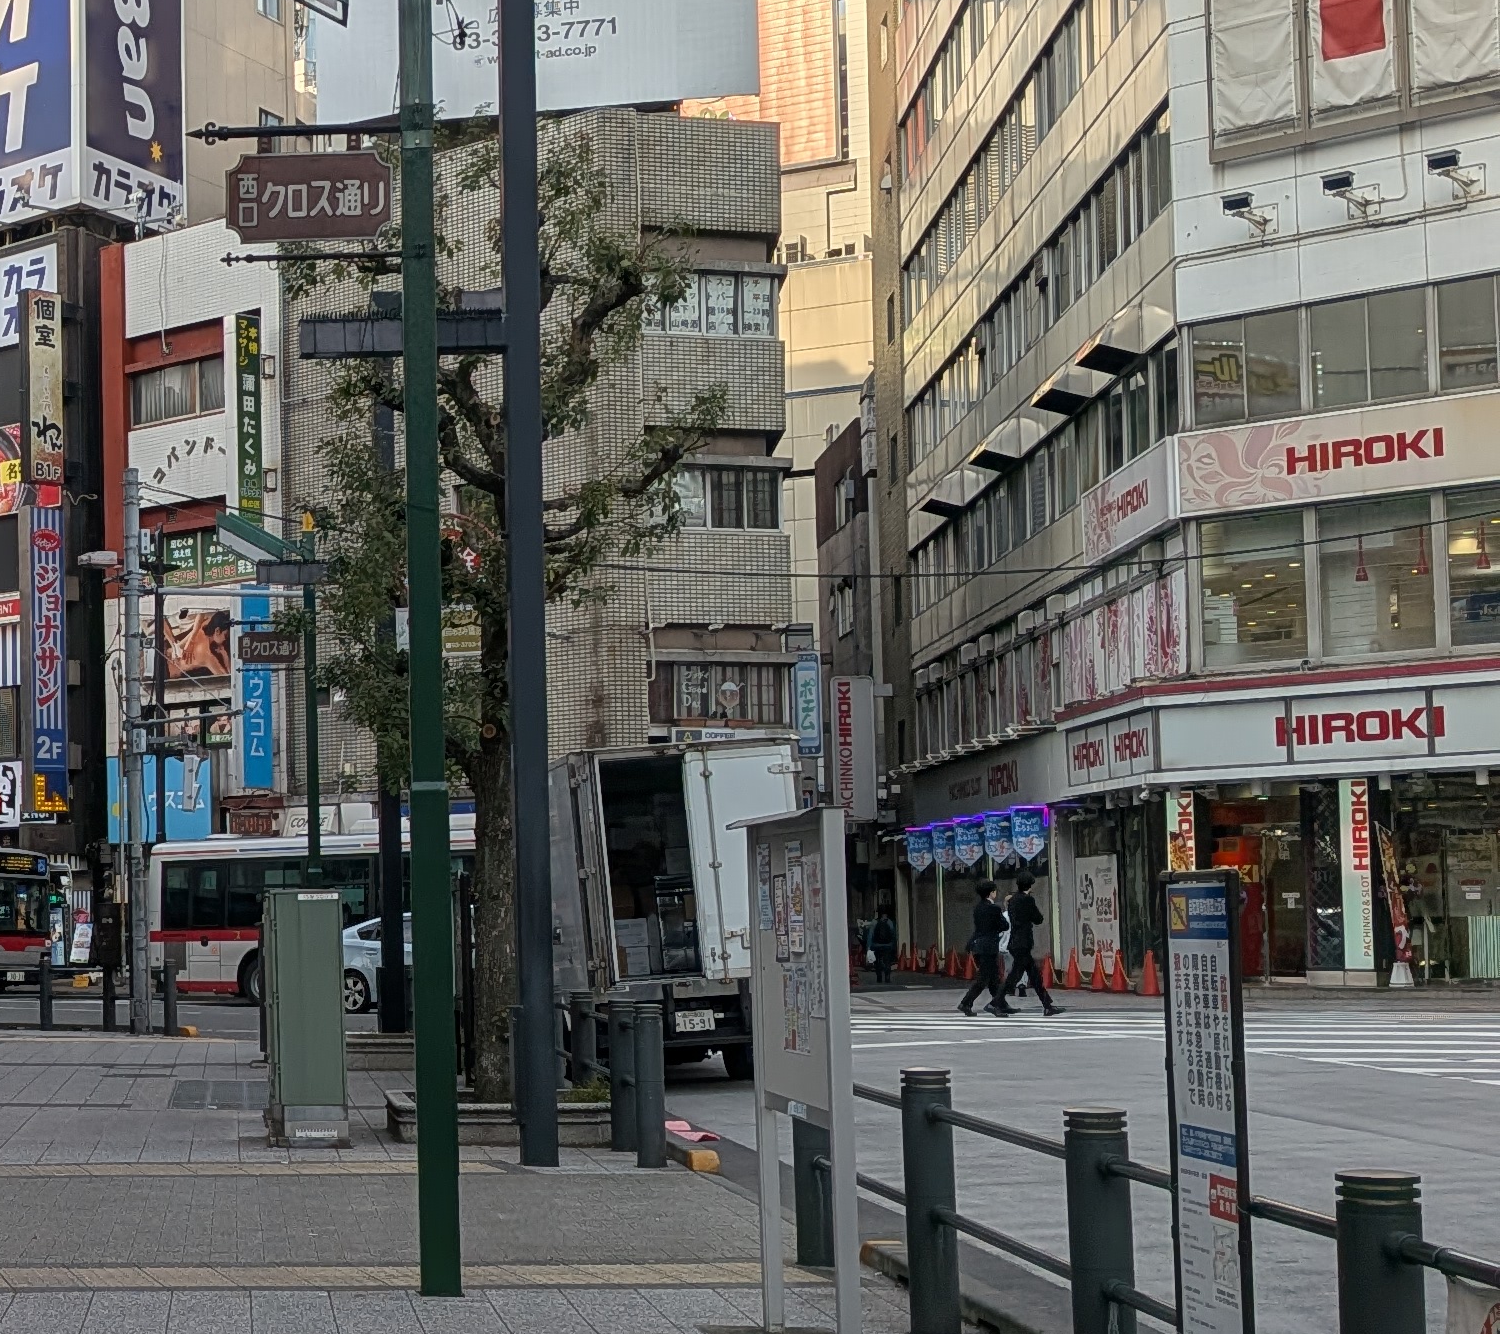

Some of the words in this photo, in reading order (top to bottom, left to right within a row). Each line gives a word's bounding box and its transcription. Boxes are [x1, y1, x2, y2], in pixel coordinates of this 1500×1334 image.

[92, 159, 180, 226] カラオケ
[237, 172, 258, 227] 西口
[261, 179, 385, 219] クロス通り
[3, 256, 46, 301] カラ
[33, 297, 58, 350] 個室
[238, 319, 249, 367] マッサージ
[248, 326, 258, 356] 本格
[242, 373, 258, 477] 蒲田たくみ
[34, 462, 61, 481] B1F
[1286, 427, 1444, 476] HIROKI
[1117, 478, 1149, 523] HIROKI
[34, 565, 62, 708] ジョナサン
[251, 640, 299, 657] クロス通り
[800, 678, 816, 731] ポエム
[837, 681, 852, 747] HIROKI
[1275, 705, 1445, 747] HIROKI
[36, 735, 62, 760] 2F
[1073, 738, 1104, 772] HIROKI
[1113, 726, 1149, 761] HIROKI
[1351, 780, 1368, 872] HIROKI
[1360, 875, 1370, 898] SLOT
[1363, 908, 1372, 957] PACHINKO
[683, 1017, 712, 1031] 15-91
